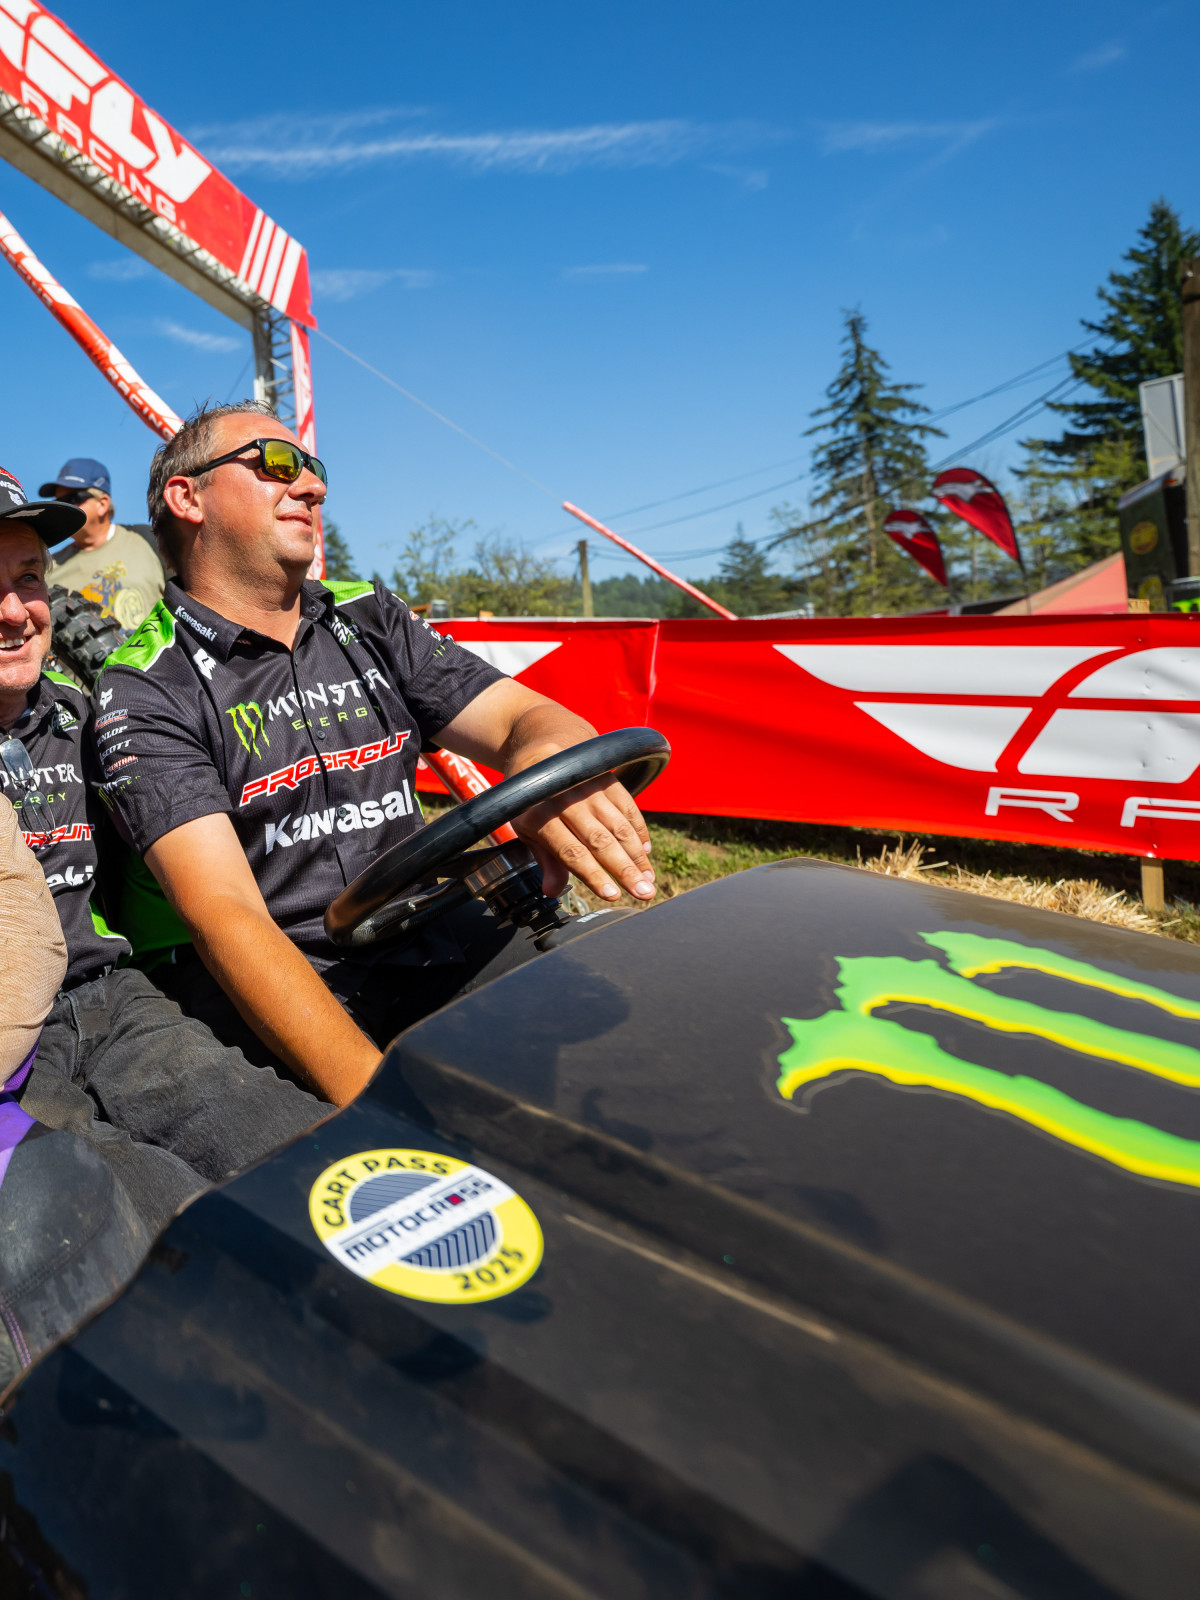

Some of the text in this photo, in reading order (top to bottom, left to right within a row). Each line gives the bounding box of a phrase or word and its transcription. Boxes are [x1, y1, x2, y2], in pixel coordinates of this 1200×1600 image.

[21, 80, 178, 223] RACING
[174, 605, 218, 642] Kawasaki
[267, 668, 391, 722] MONSTR
[323, 1156, 452, 1227] CART PASS
[344, 1178, 493, 1263] MOTOCROSS
[455, 1246, 525, 1291] 2025
